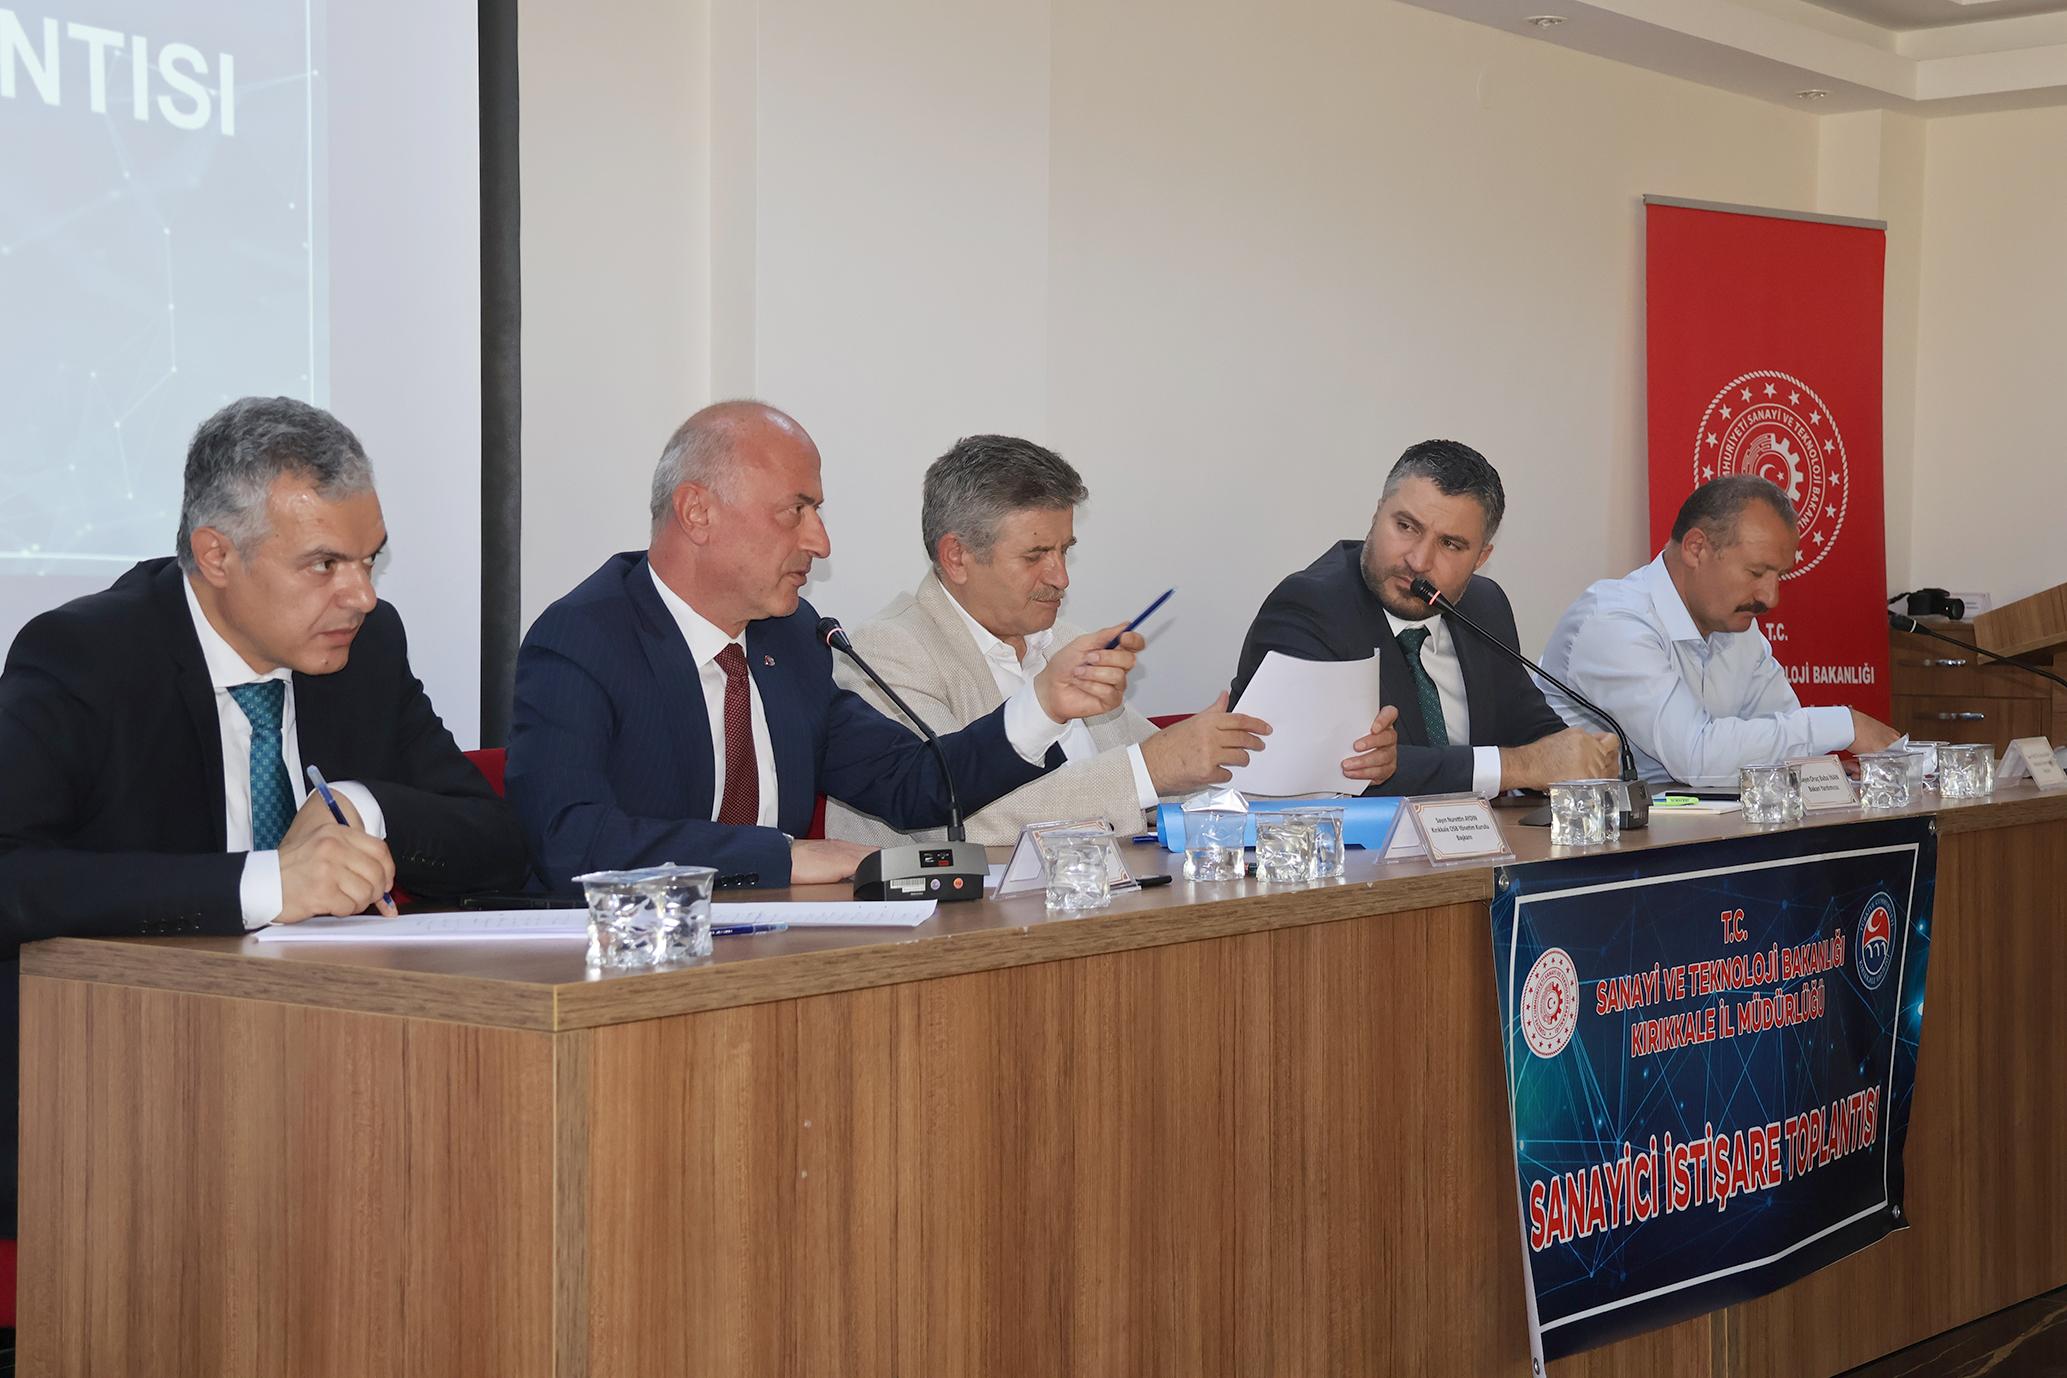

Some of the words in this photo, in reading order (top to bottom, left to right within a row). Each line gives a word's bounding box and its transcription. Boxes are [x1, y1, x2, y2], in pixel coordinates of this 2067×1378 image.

[1747, 409, 1781, 425] SANAYİ
[1782, 413, 1794, 426] VE
[1794, 422, 1823, 484] TEKNOLOJİ
[1798, 487, 1820, 529] BAKANL
[1765, 623, 1788, 641] T.C.
[1813, 662, 1875, 684] BAKANLIĞI
[1720, 908, 1748, 944] T.C.
[1596, 962, 1660, 1015] SANAYİ
[1663, 965, 1685, 1001] VE
[1688, 942, 1778, 998] TEKNOLOJİ
[1782, 928, 1846, 980] BAKANLIĞI
[1631, 1007, 1715, 1058] KIRIKKALE
[1719, 998, 1735, 1039] İL
[1737, 978, 1825, 1034] MÜDÜRLÜĞÜ
[1529, 1135, 1659, 1252] SANAYİCİ
[1664, 1121, 1781, 1213] İSTİŞARE
[1784, 1085, 1880, 1181] TOPLANTISI
